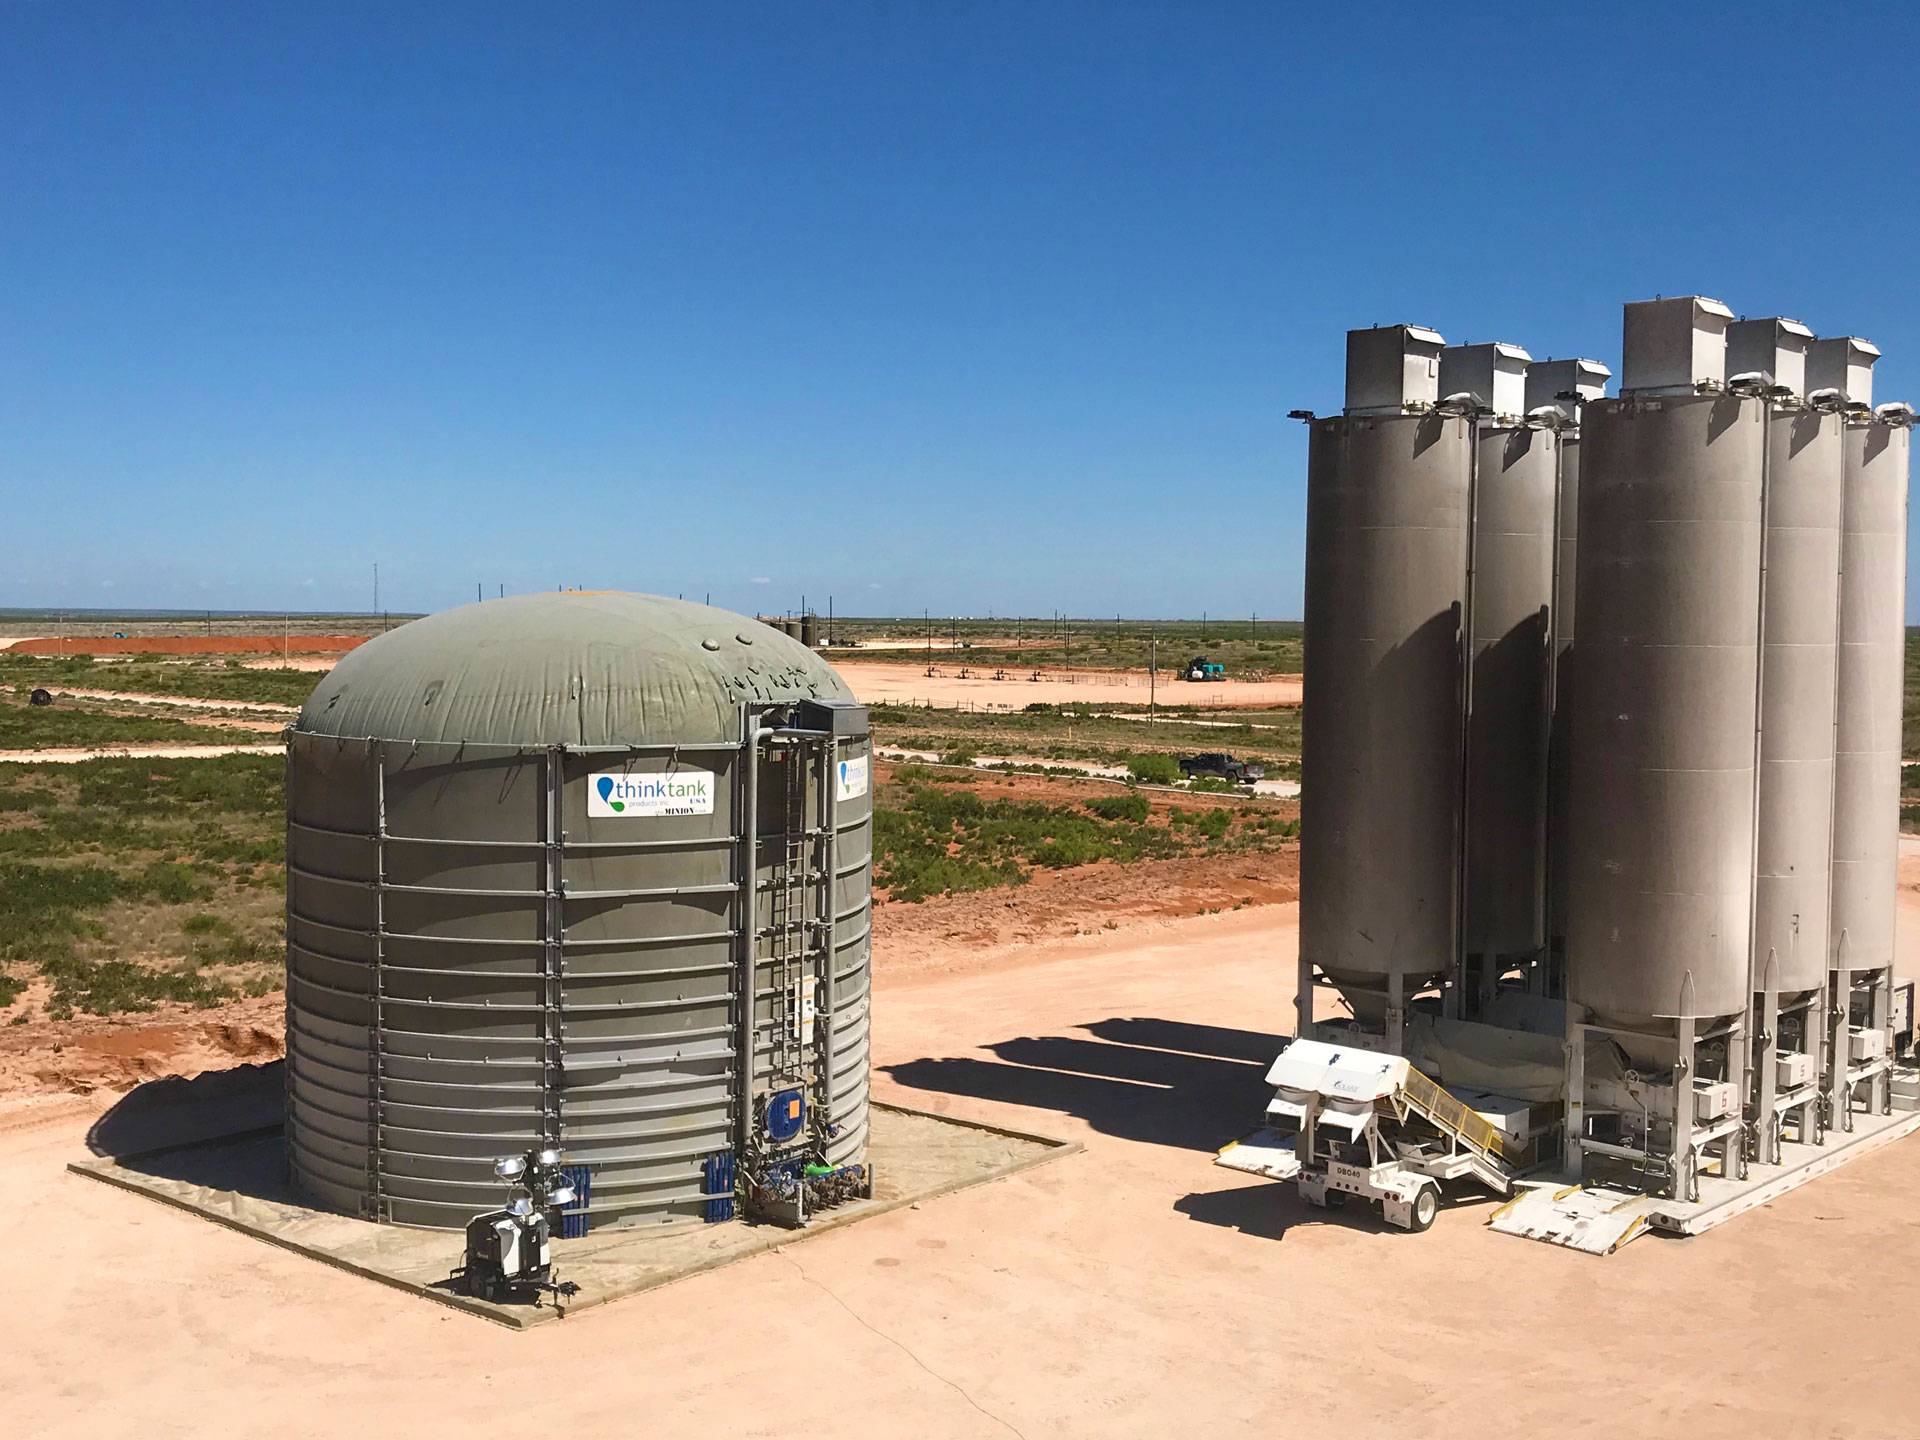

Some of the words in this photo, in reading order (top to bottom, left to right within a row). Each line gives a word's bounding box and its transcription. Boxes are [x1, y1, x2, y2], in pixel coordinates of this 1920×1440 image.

[628, 800, 658, 808] products
[665, 807, 694, 815] MINION
[1800, 1064, 1805, 1077] 5
[1722, 1091, 1727, 1108] 6
